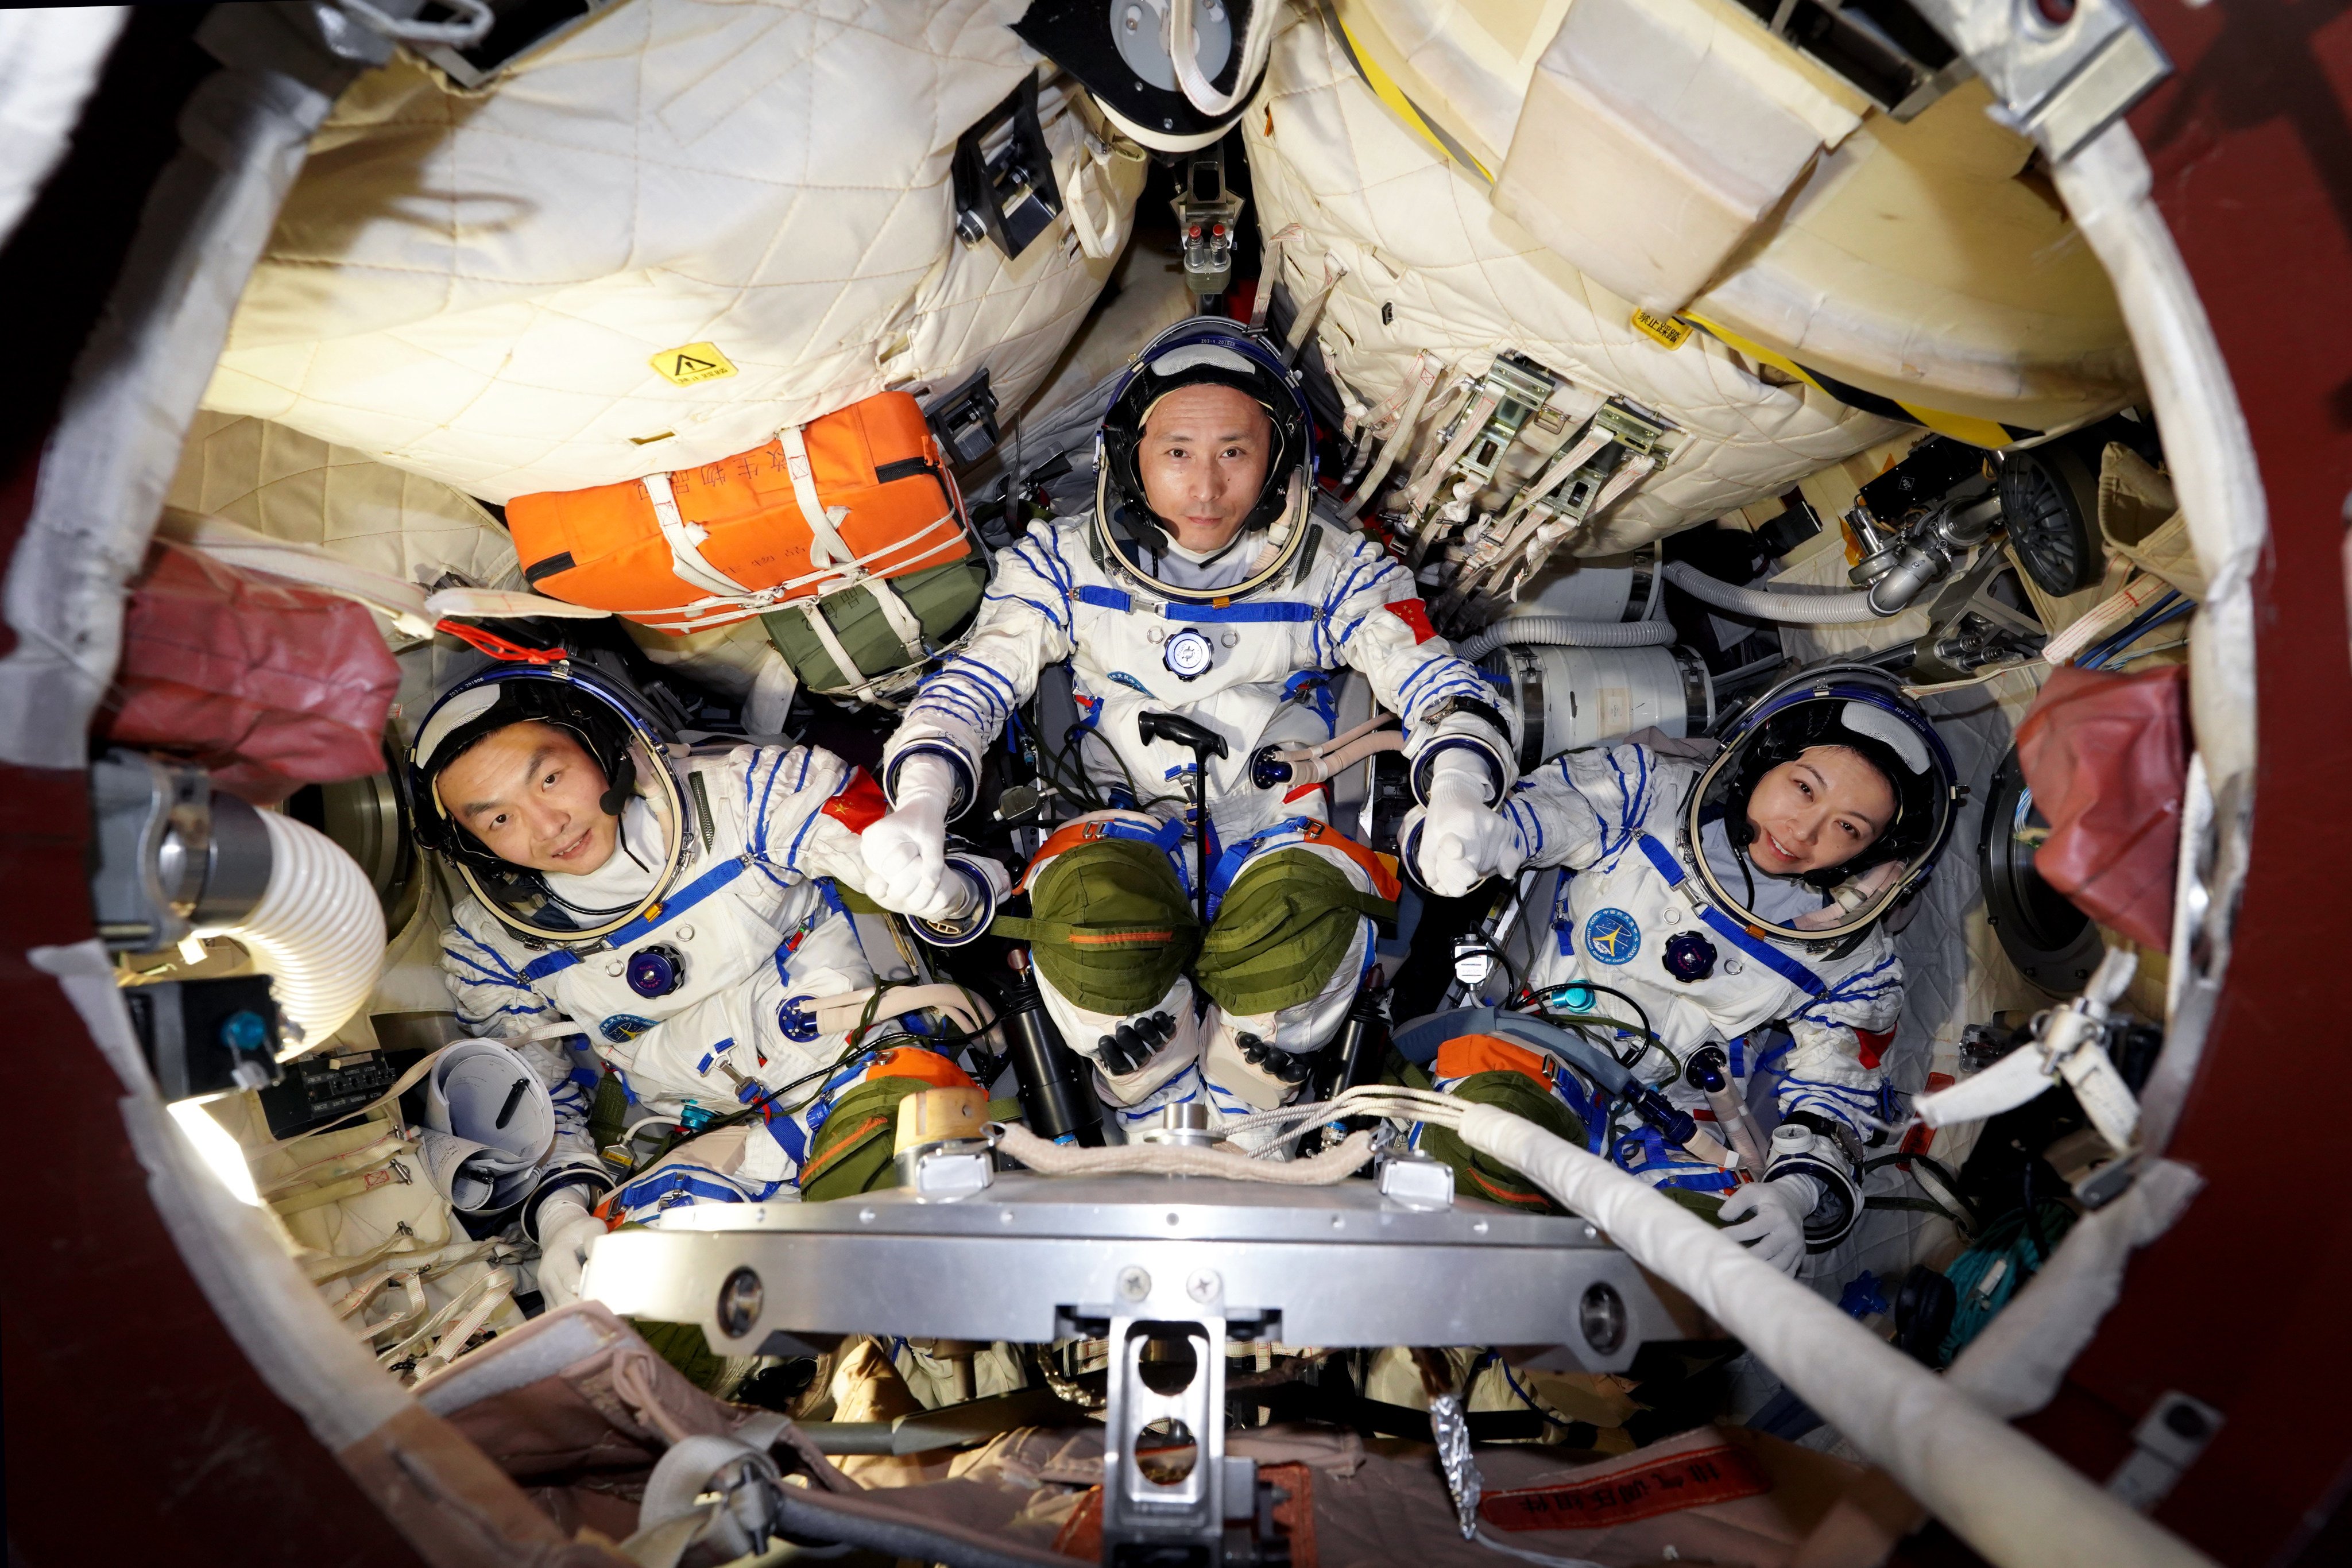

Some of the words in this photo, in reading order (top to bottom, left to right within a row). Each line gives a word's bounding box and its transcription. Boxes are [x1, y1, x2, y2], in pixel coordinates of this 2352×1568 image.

[1638, 312, 1681, 343] 禁止踩踏
[465, 677, 484, 688] 201906
[1910, 717, 1927, 733] 201906
[1592, 950, 1604, 961] CENTER
